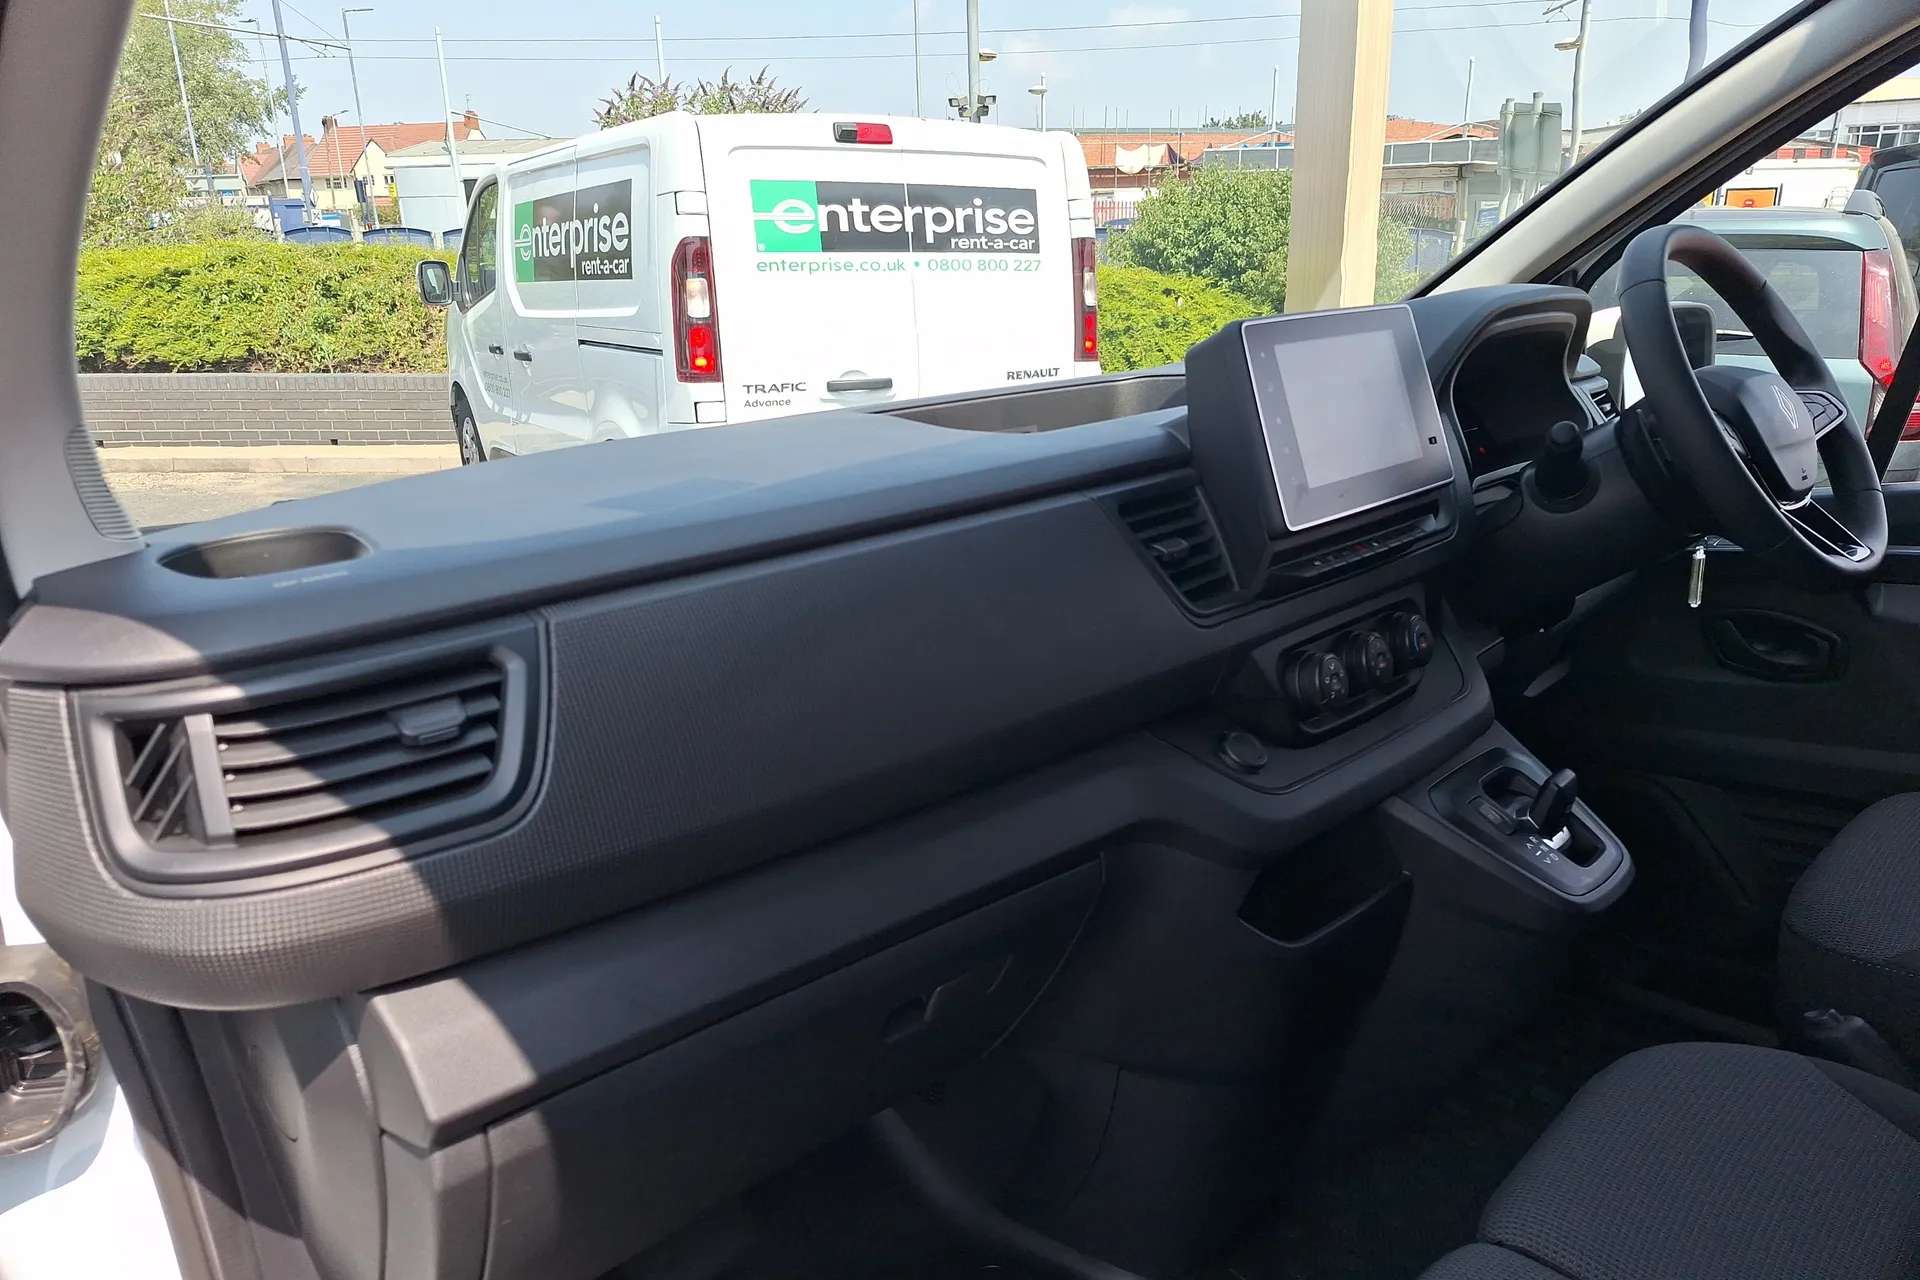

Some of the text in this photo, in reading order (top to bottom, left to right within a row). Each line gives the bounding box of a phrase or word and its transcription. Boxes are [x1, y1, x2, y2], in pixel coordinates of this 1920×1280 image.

[771, 198, 1035, 243] enterprise
[519, 202, 629, 268] enterprise
[951, 235, 1035, 250] rent-a-car
[581, 257, 629, 275] rent-a-car
[756, 257, 1041, 275] enterprise.co.uk 0800 800 227
[1006, 367, 1060, 381] RENAULT
[742, 381, 806, 395] TRAFIC
[743, 397, 791, 408] Advance
